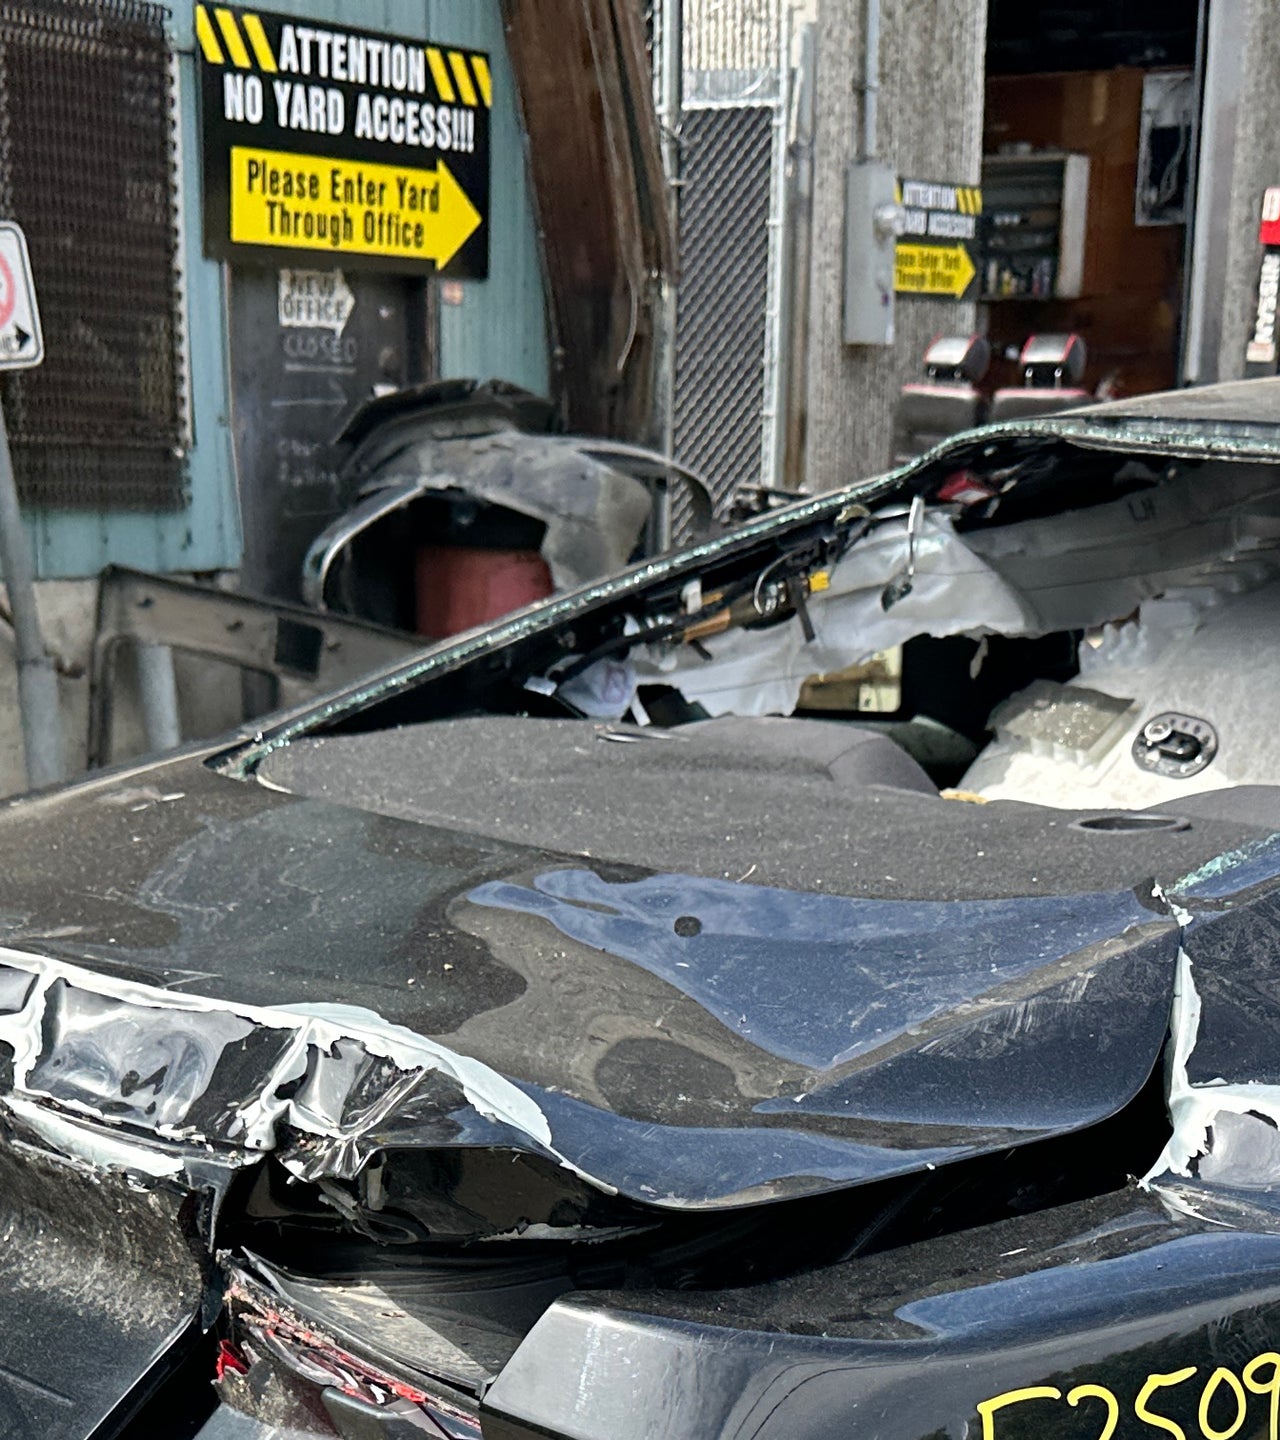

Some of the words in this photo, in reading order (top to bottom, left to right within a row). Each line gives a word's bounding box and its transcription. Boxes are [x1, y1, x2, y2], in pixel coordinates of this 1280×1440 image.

[279, 24, 426, 94] ATTENTION
[223, 72, 264, 124] NO
[272, 80, 345, 135] YARD
[354, 93, 475, 153] ACCESS!!!
[247, 159, 320, 200] Please
[330, 168, 386, 208] Enter
[396, 175, 440, 214] Yard
[266, 201, 354, 247] Through
[363, 211, 425, 249] Office
